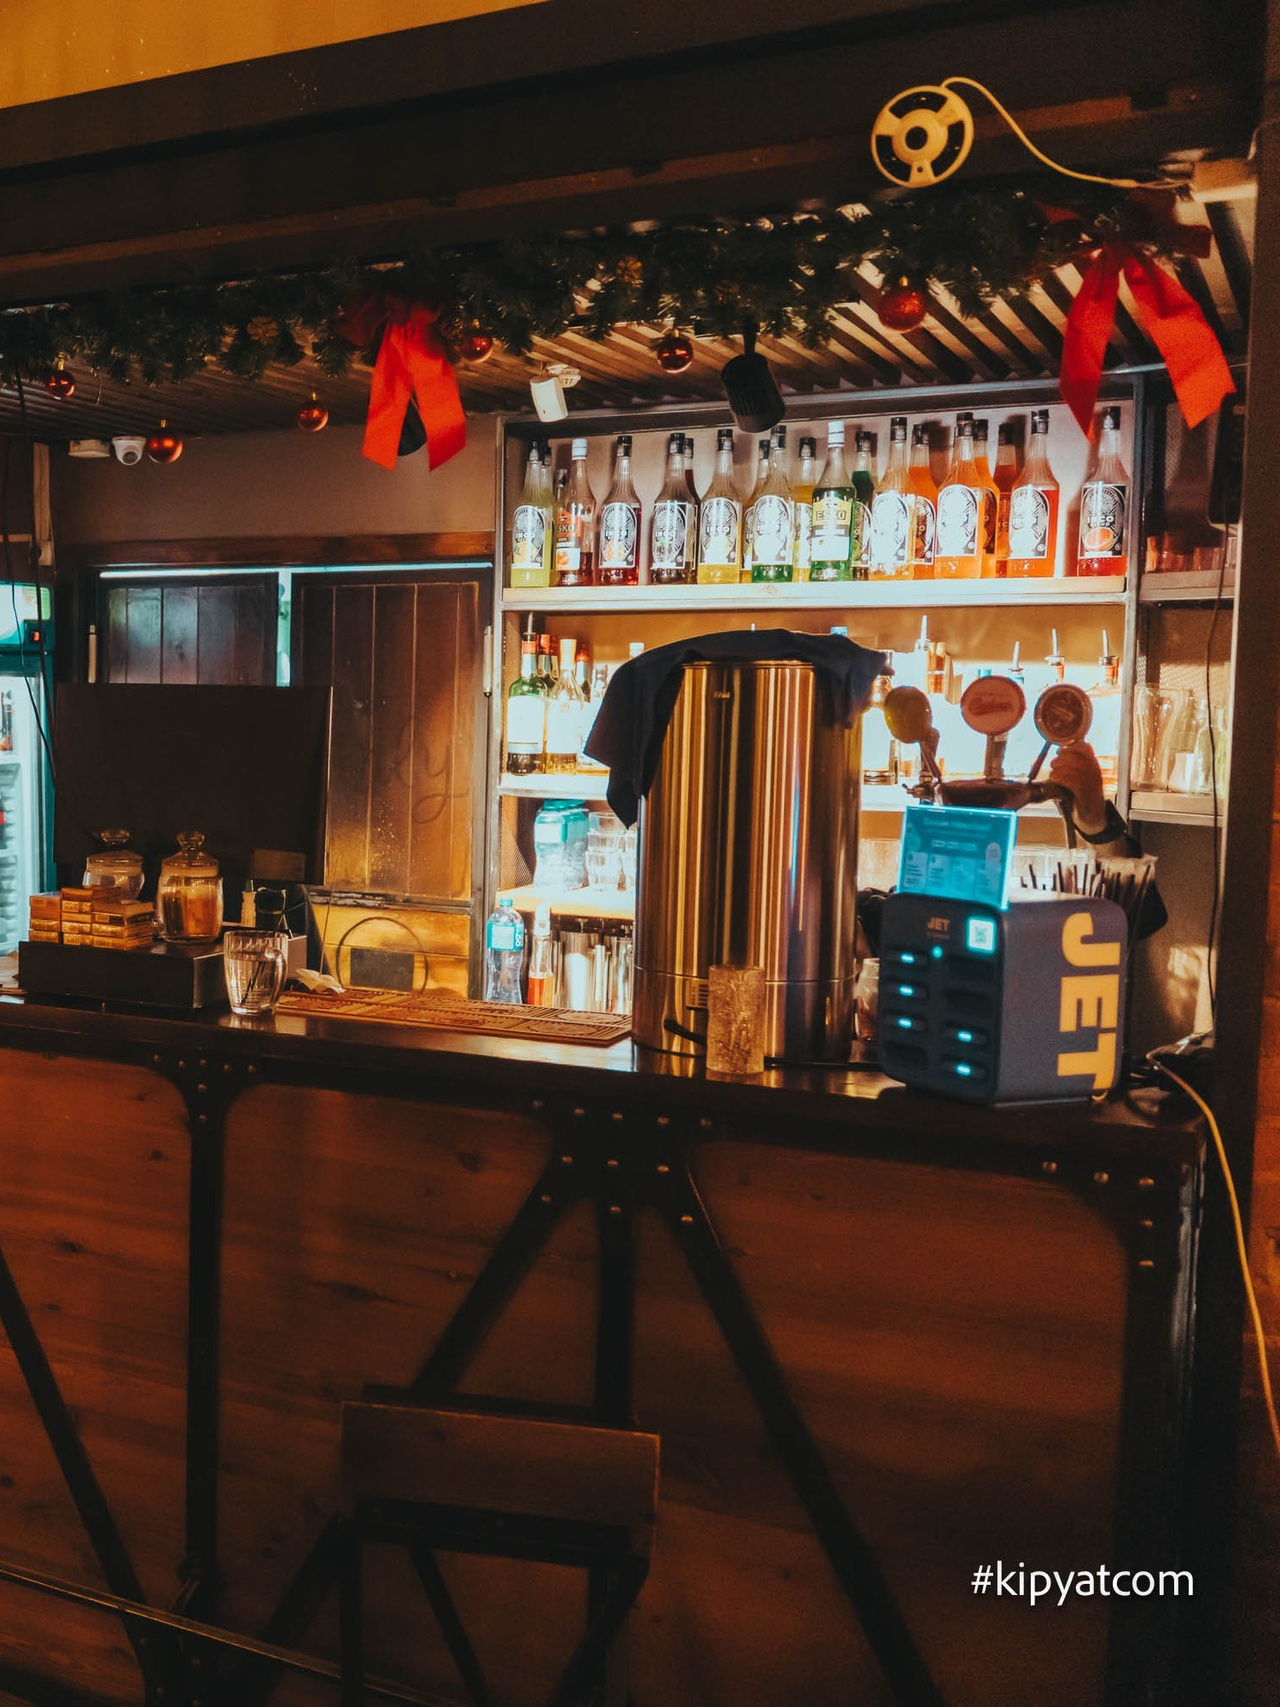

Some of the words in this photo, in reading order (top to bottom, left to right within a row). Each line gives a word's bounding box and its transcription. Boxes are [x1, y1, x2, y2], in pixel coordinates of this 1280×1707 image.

[816, 510, 846, 521] ESO
[927, 917, 950, 932] JET
[1056, 911, 1122, 1090] JET
